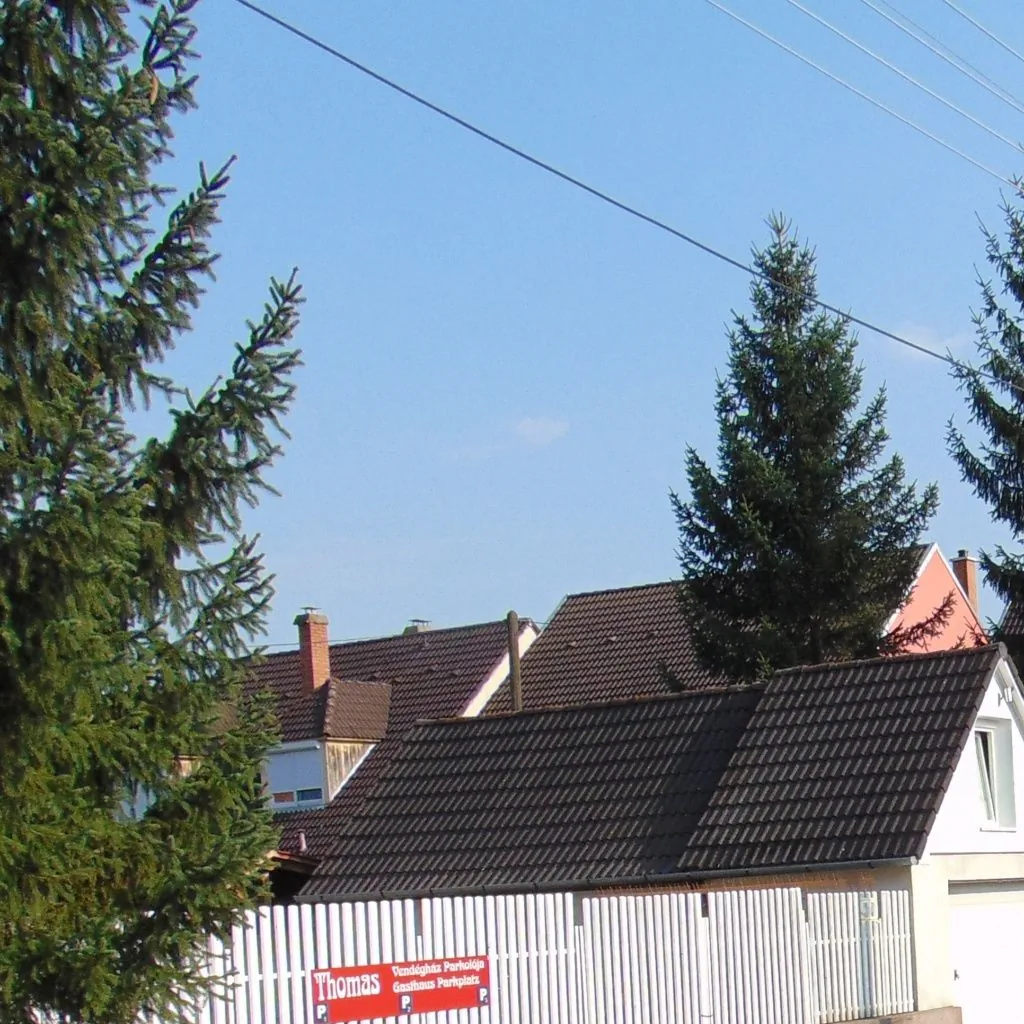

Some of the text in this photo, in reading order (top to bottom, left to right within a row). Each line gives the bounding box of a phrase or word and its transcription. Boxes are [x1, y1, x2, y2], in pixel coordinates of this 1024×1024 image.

[392, 959, 485, 977] Vendégház Parkolója
[313, 971, 381, 1001] Thomas
[392, 974, 480, 993] Gasthaus Parkplatz
